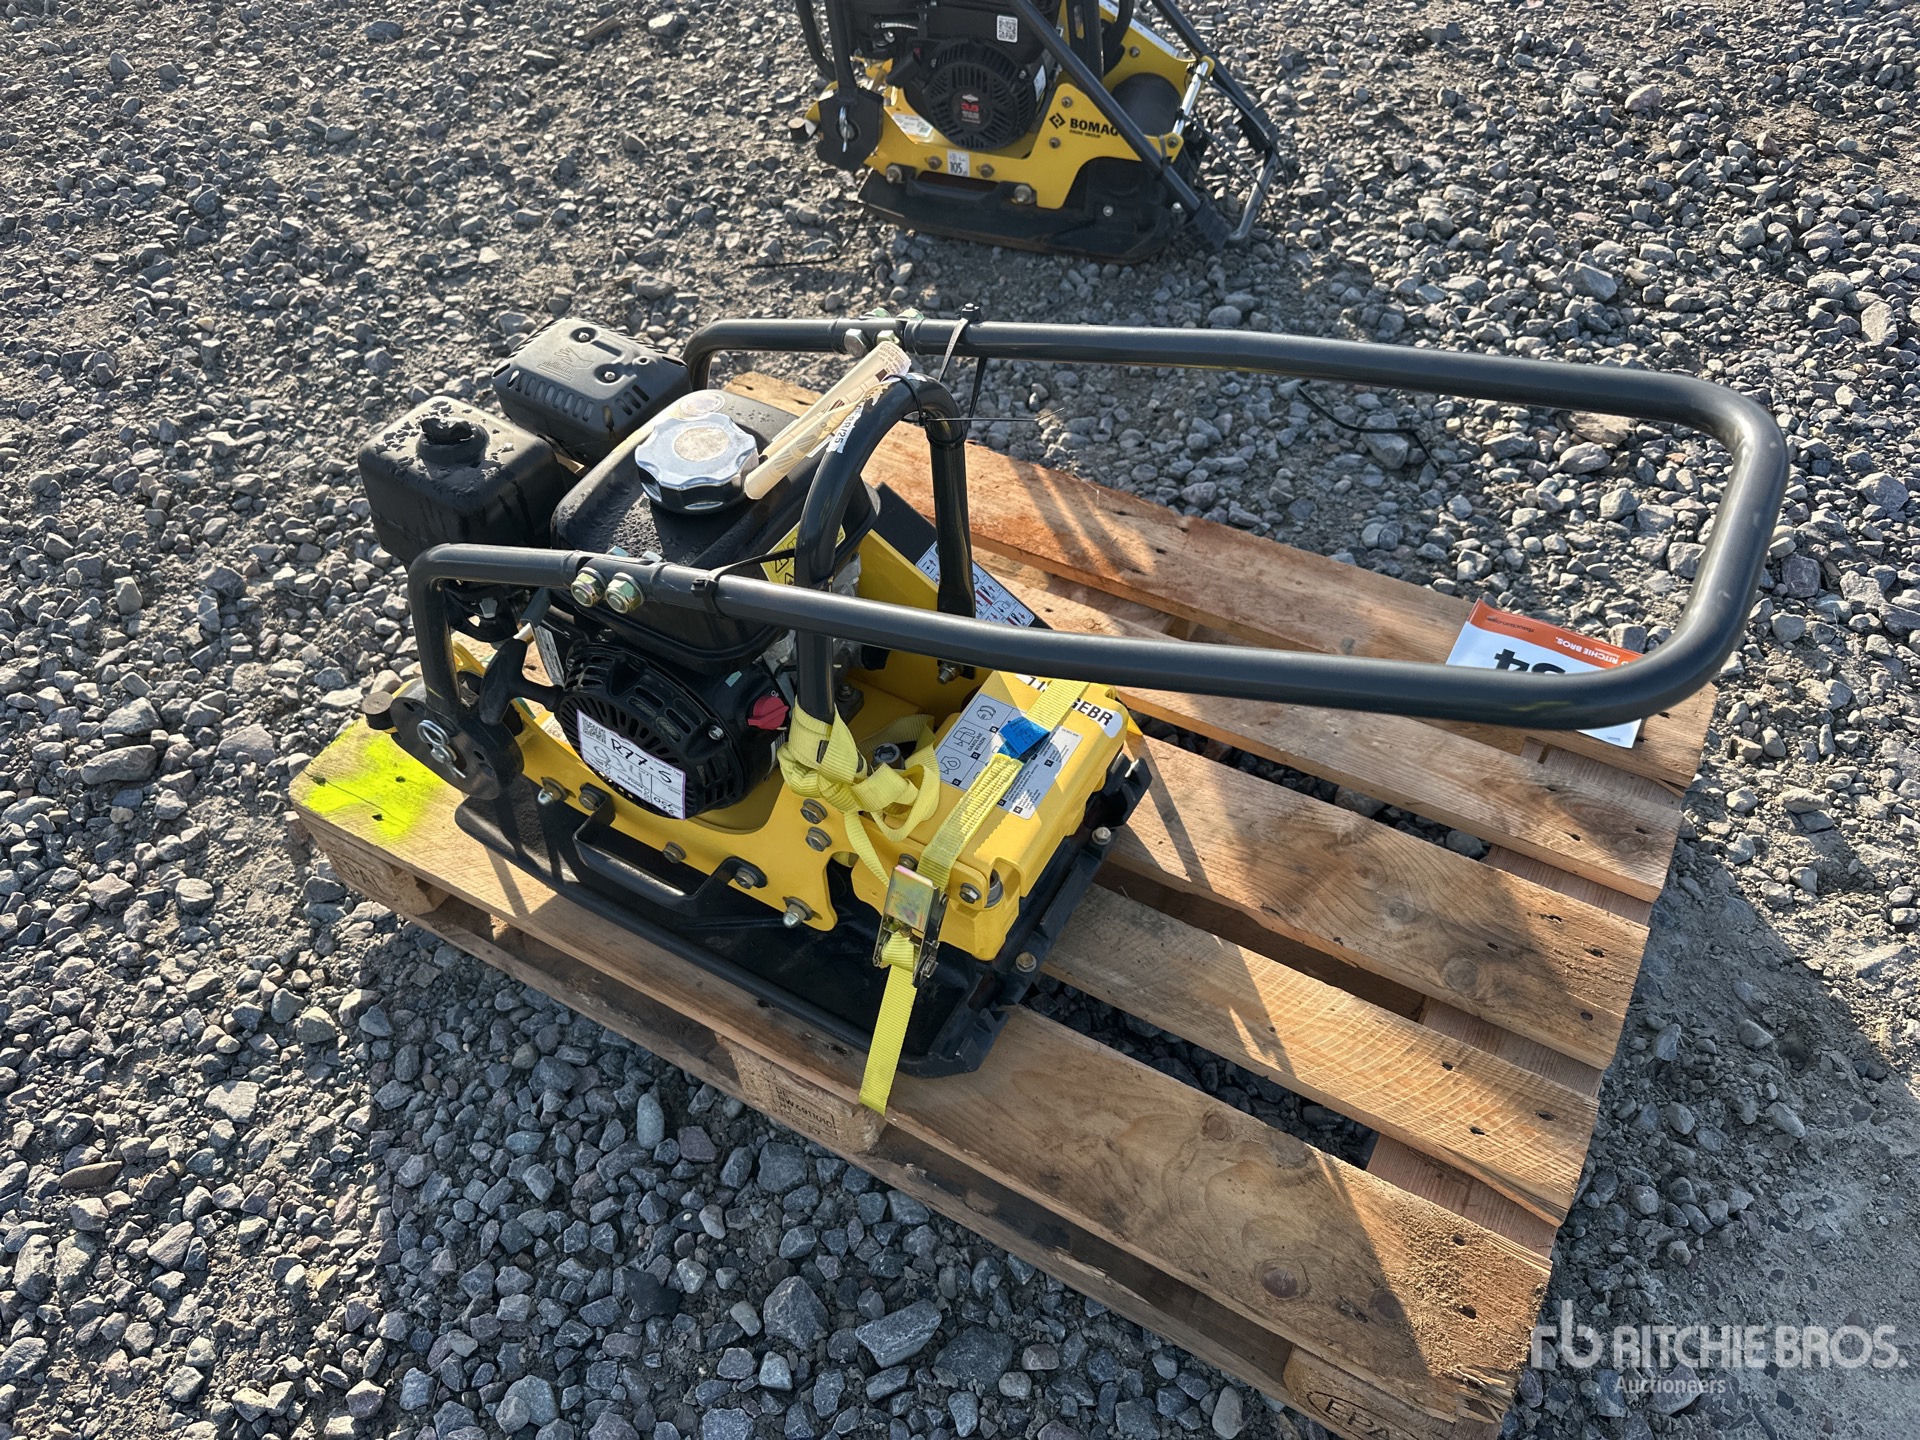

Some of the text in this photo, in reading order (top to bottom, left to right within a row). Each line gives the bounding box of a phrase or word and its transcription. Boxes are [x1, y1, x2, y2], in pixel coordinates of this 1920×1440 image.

[1070, 118, 1118, 136] BOMAG
[1555, 636, 1582, 653] BROS.
[1583, 647, 1619, 665] RITCHIE
